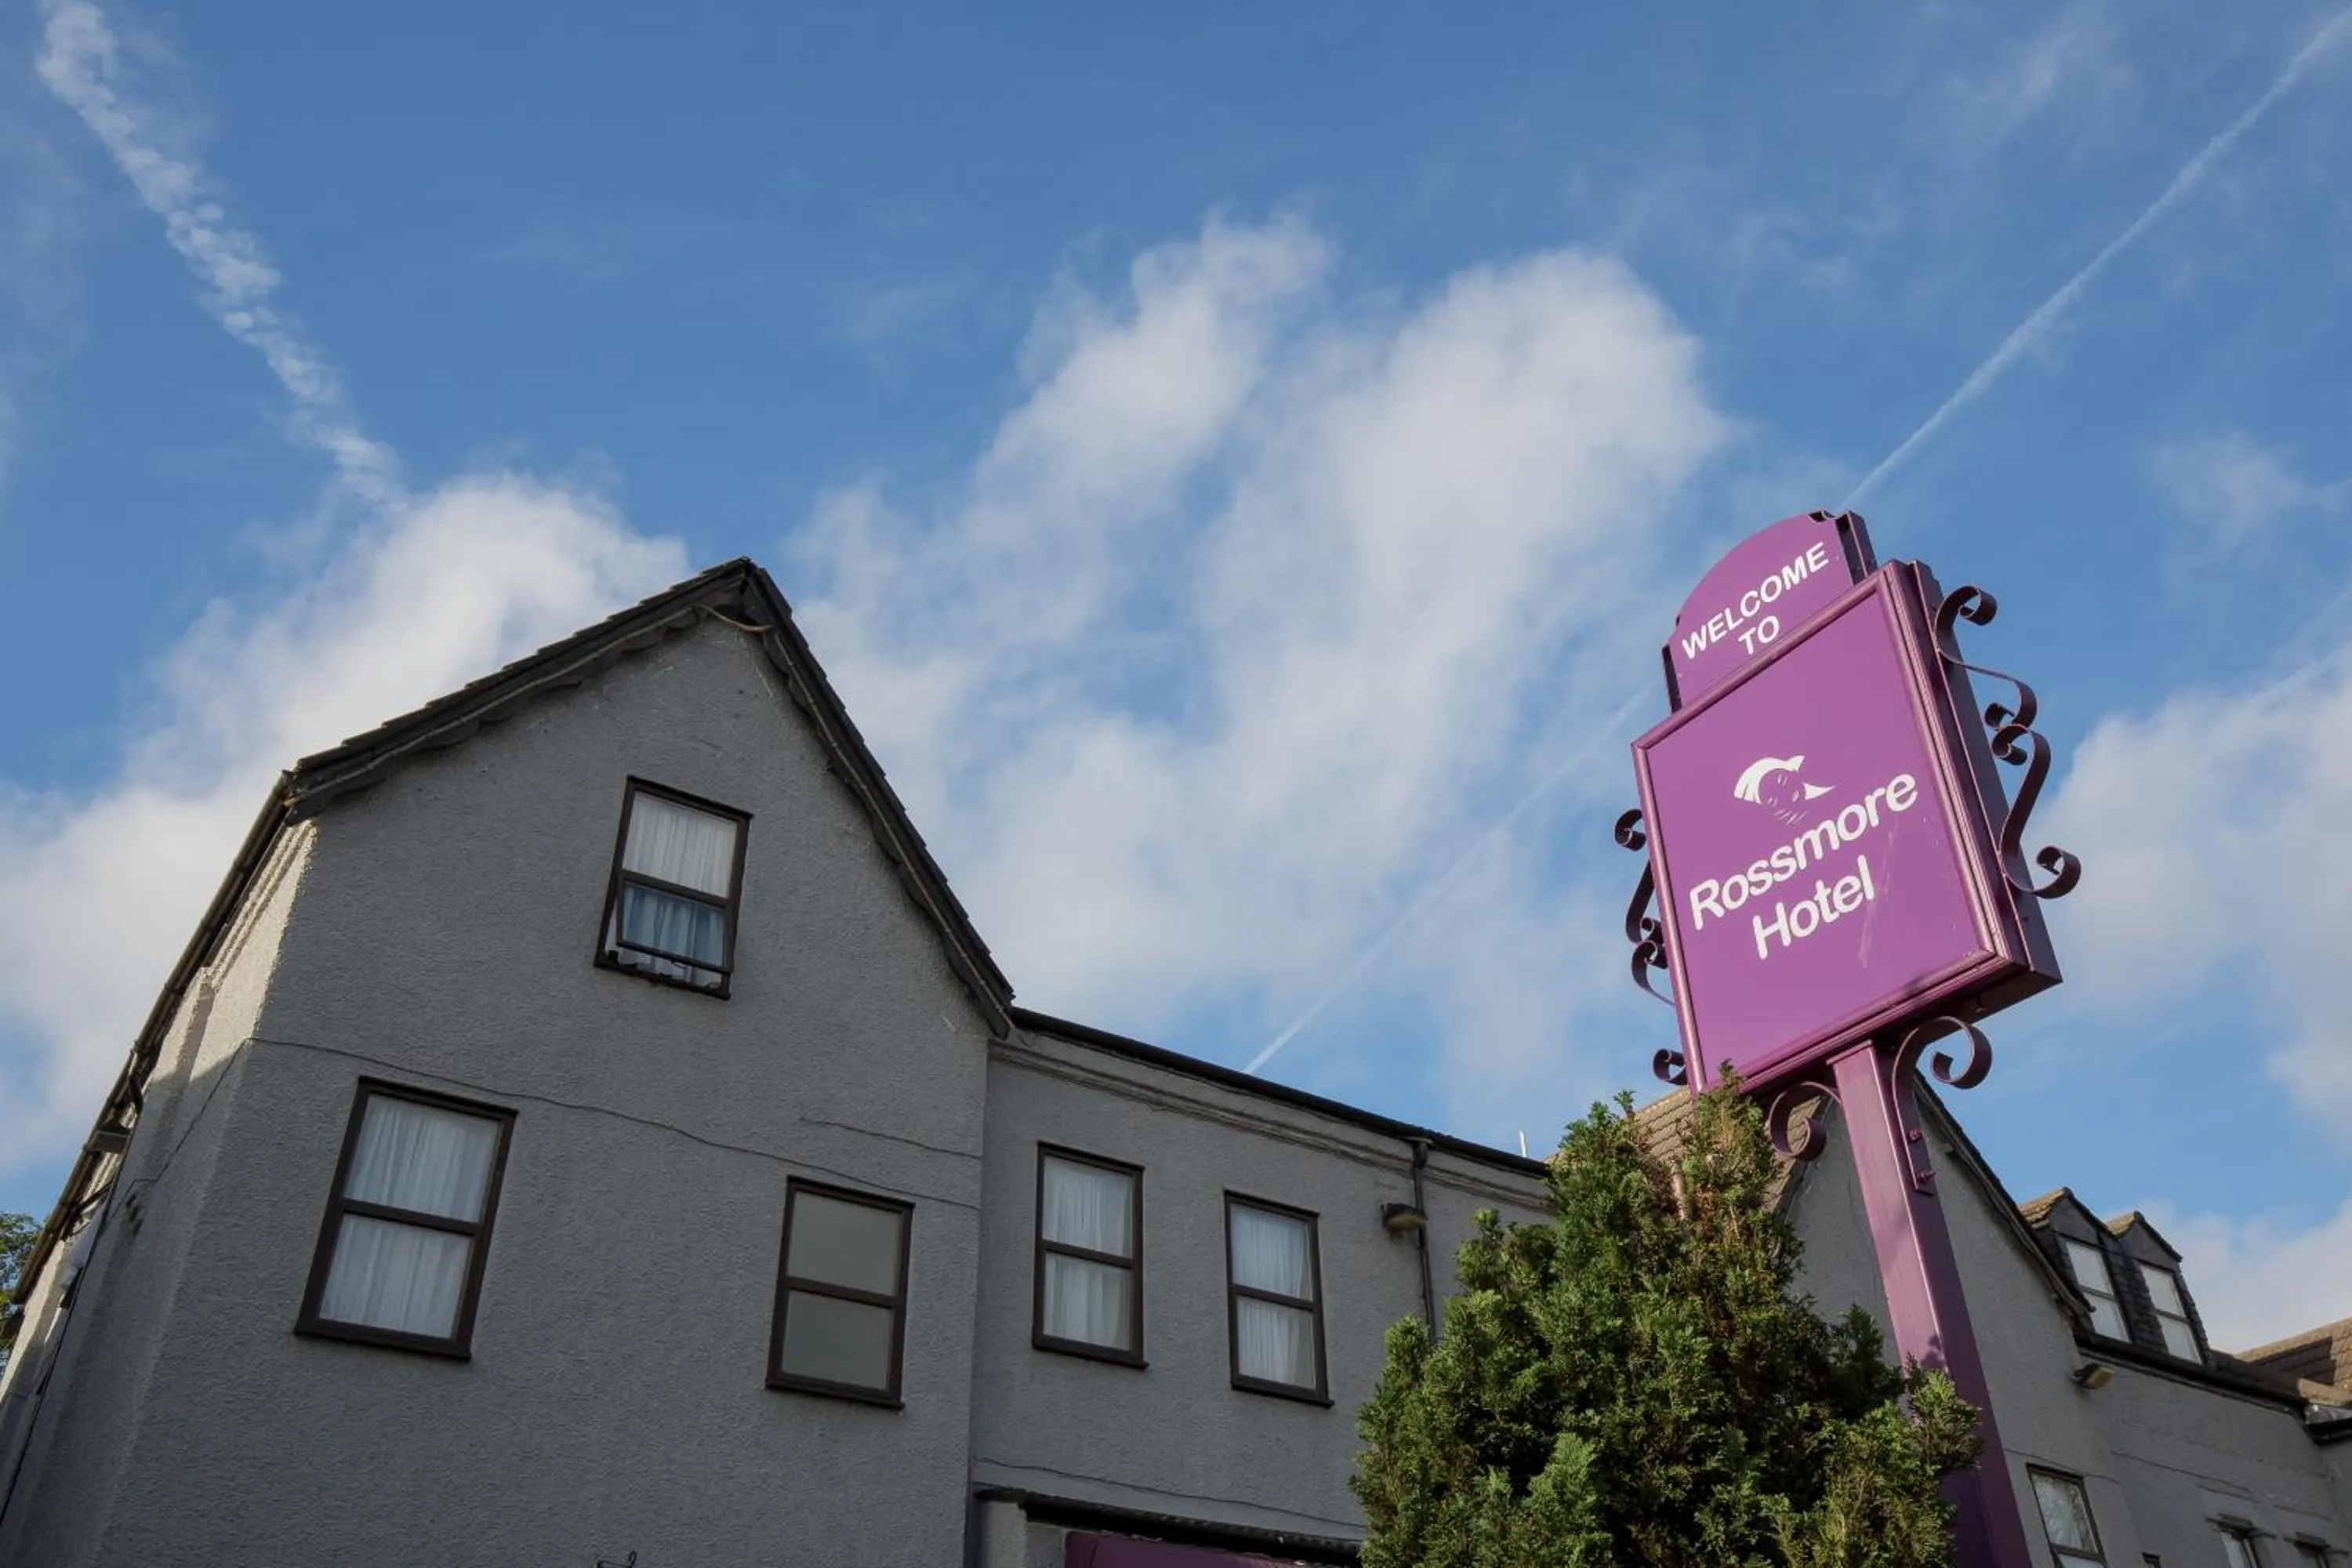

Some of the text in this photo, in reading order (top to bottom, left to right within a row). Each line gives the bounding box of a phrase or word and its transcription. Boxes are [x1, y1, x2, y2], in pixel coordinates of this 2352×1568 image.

[1682, 542, 1830, 659] WELCOME
[1737, 615, 1780, 655] TO
[1688, 773, 1918, 930] Rossmore
[1751, 855, 1875, 960] Hotel
